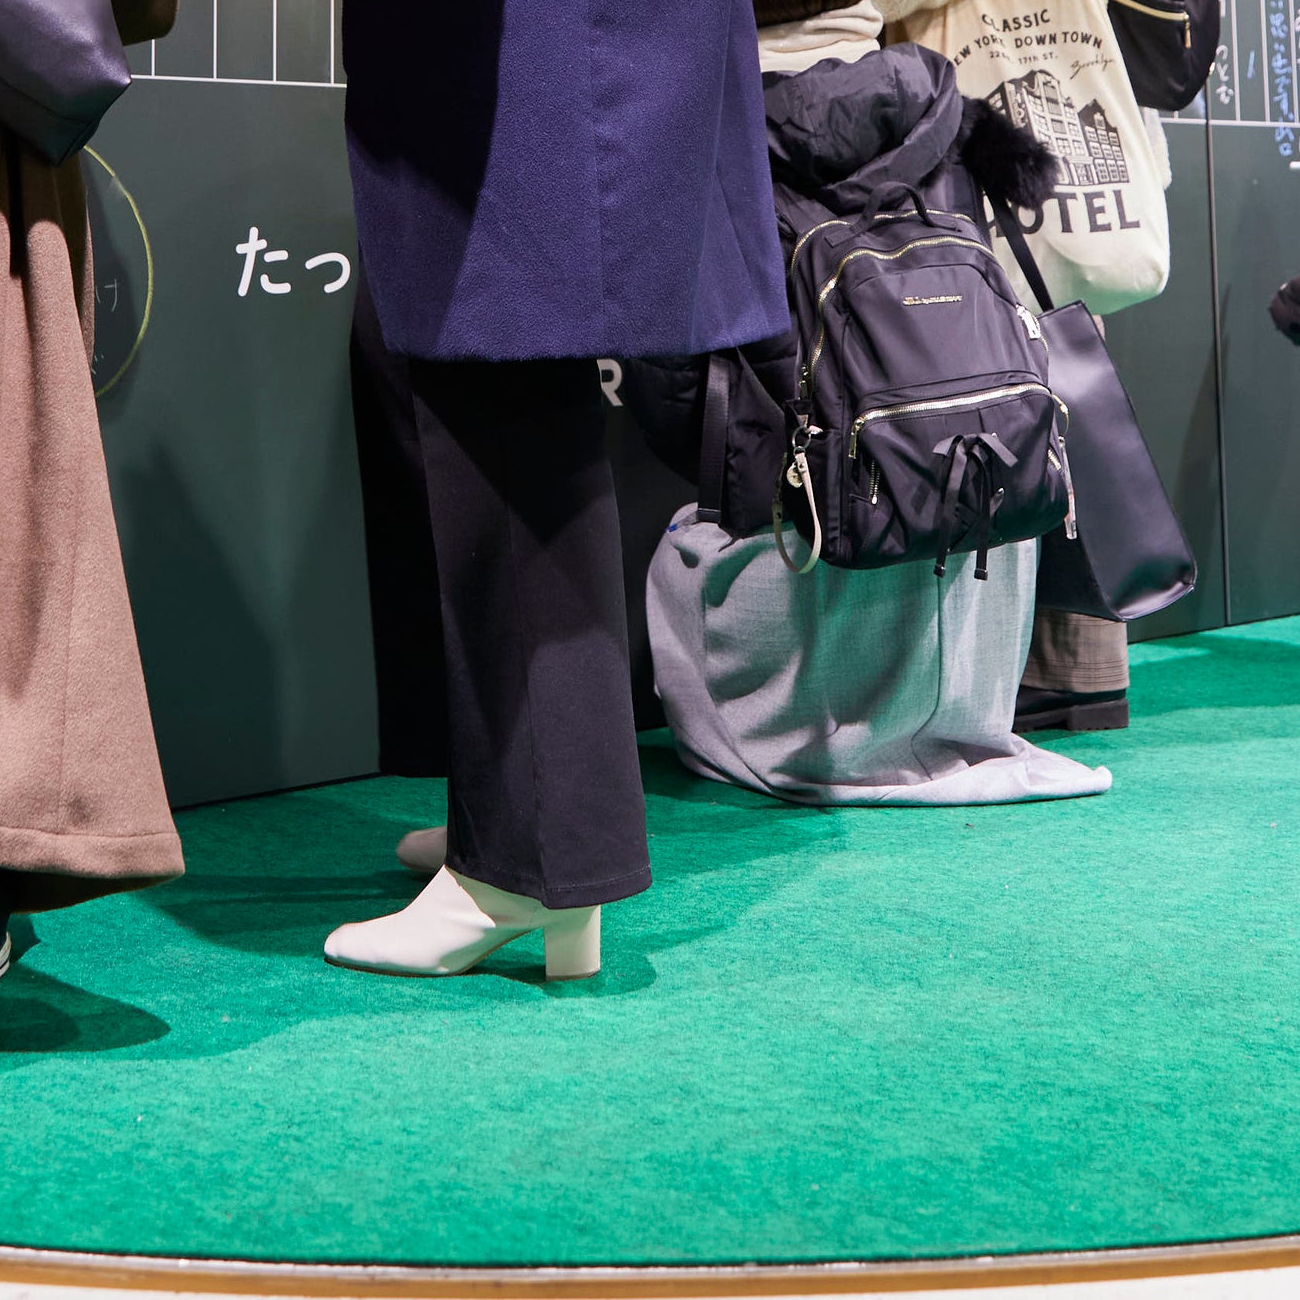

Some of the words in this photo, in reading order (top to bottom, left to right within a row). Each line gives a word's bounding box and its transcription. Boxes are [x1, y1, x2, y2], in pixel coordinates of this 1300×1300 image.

[982, 9, 1051, 33] CLASSIC
[953, 46, 970, 66] EW
[1015, 32, 1057, 49] DOWN
[1061, 31, 1103, 49] TOWN
